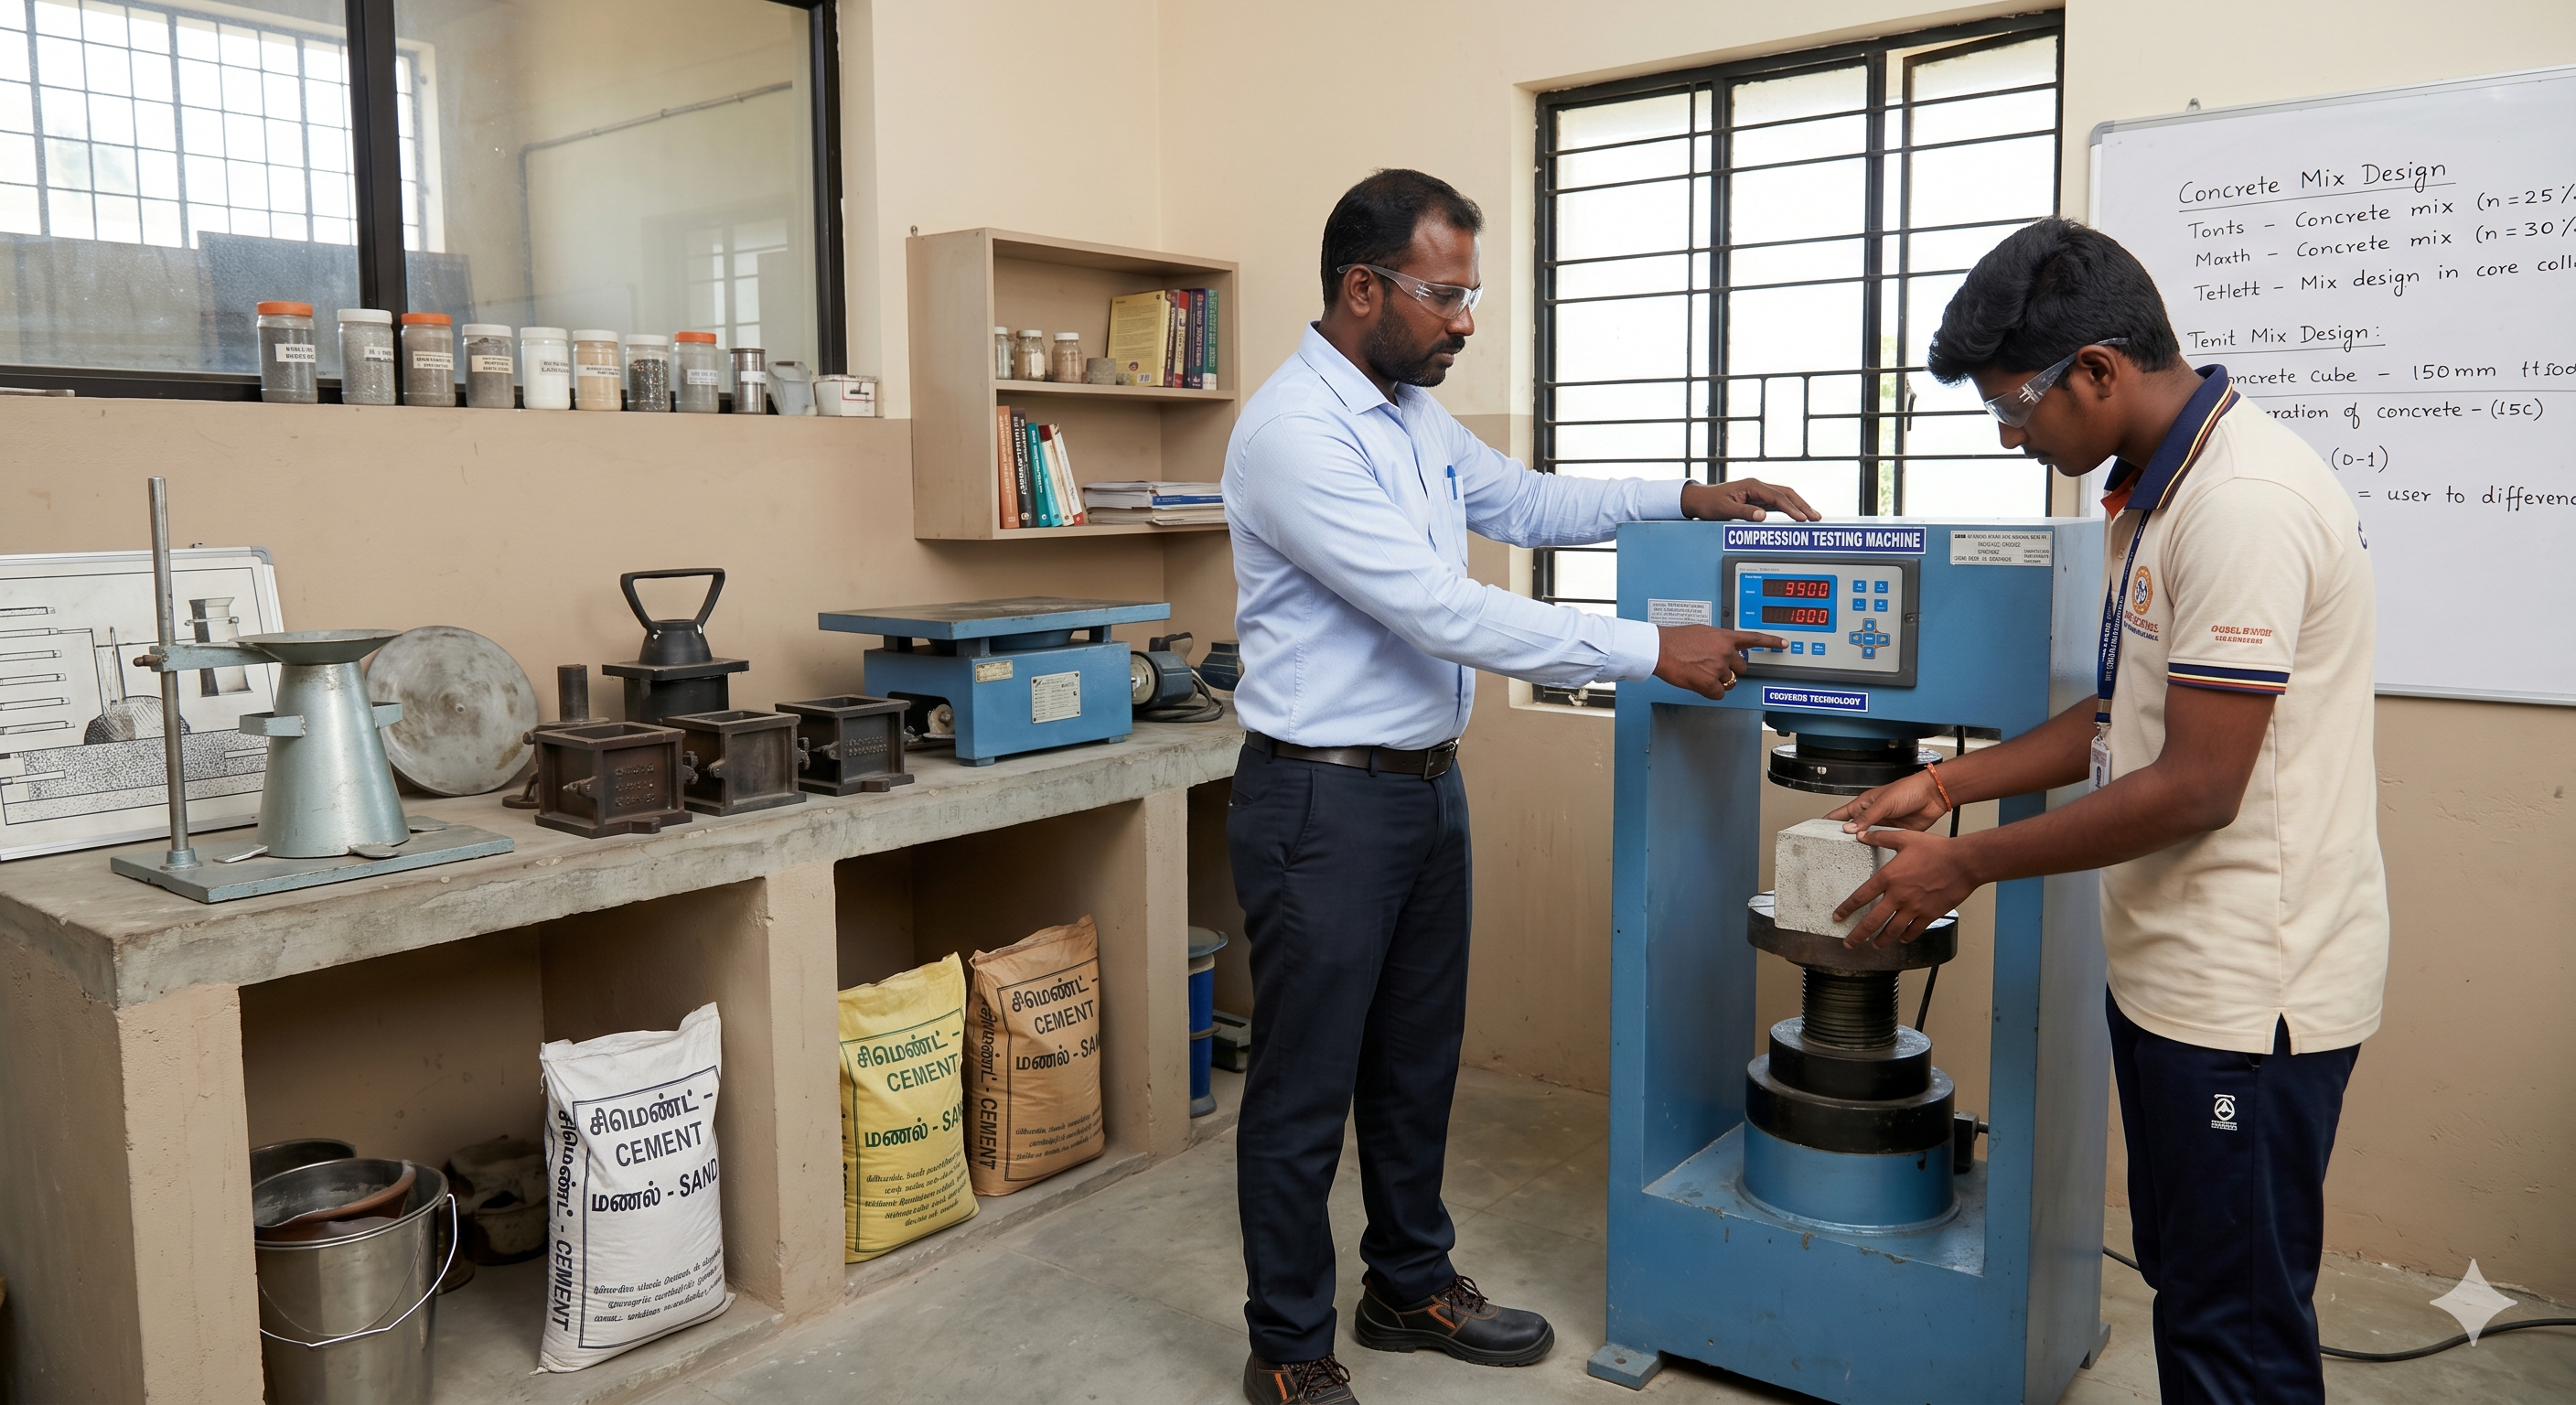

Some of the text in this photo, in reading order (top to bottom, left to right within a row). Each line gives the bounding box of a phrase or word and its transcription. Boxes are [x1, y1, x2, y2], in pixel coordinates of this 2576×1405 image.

[2178, 161, 2446, 204] Concrete Mix Design
[2187, 220, 2245, 240] Tonts
[2295, 203, 2391, 228] Concrete
[2410, 198, 2453, 217] mix
[2296, 234, 2390, 257] Concrete
[2410, 230, 2453, 247] mix
[2301, 274, 2337, 291] Mix
[2353, 268, 2420, 297] design
[2439, 264, 2459, 280] in
[2476, 263, 2519, 277] core
[2537, 254, 2576, 272] coll
[2186, 328, 2237, 349] Tenit
[2251, 327, 2287, 344] Mix
[2267, 403, 2329, 420] ration
[2343, 402, 2361, 430] of
[2377, 401, 2463, 419] concrete
[2388, 489, 2432, 502] user
[2445, 485, 2465, 504] to
[1728, 530, 1921, 548] COMPRESSION TESTING MACHINE
[1790, 609, 1828, 623] 1000
[1035, 999, 1094, 1035] CEMENT
[857, 1030, 949, 1068] சிமெண்ட்
[1016, 1045, 1070, 1070] மணல்
[886, 1053, 958, 1092] CEMENT
[590, 1089, 700, 1136] சிமெண்ட்
[616, 1121, 702, 1167] CEMENT
[864, 1117, 928, 1148] மணல்
[979, 1098, 998, 1170] CEMENT
[592, 1180, 661, 1212] மணல்
[679, 1157, 718, 1197] SAND
[552, 1239, 573, 1332] CEMENT
